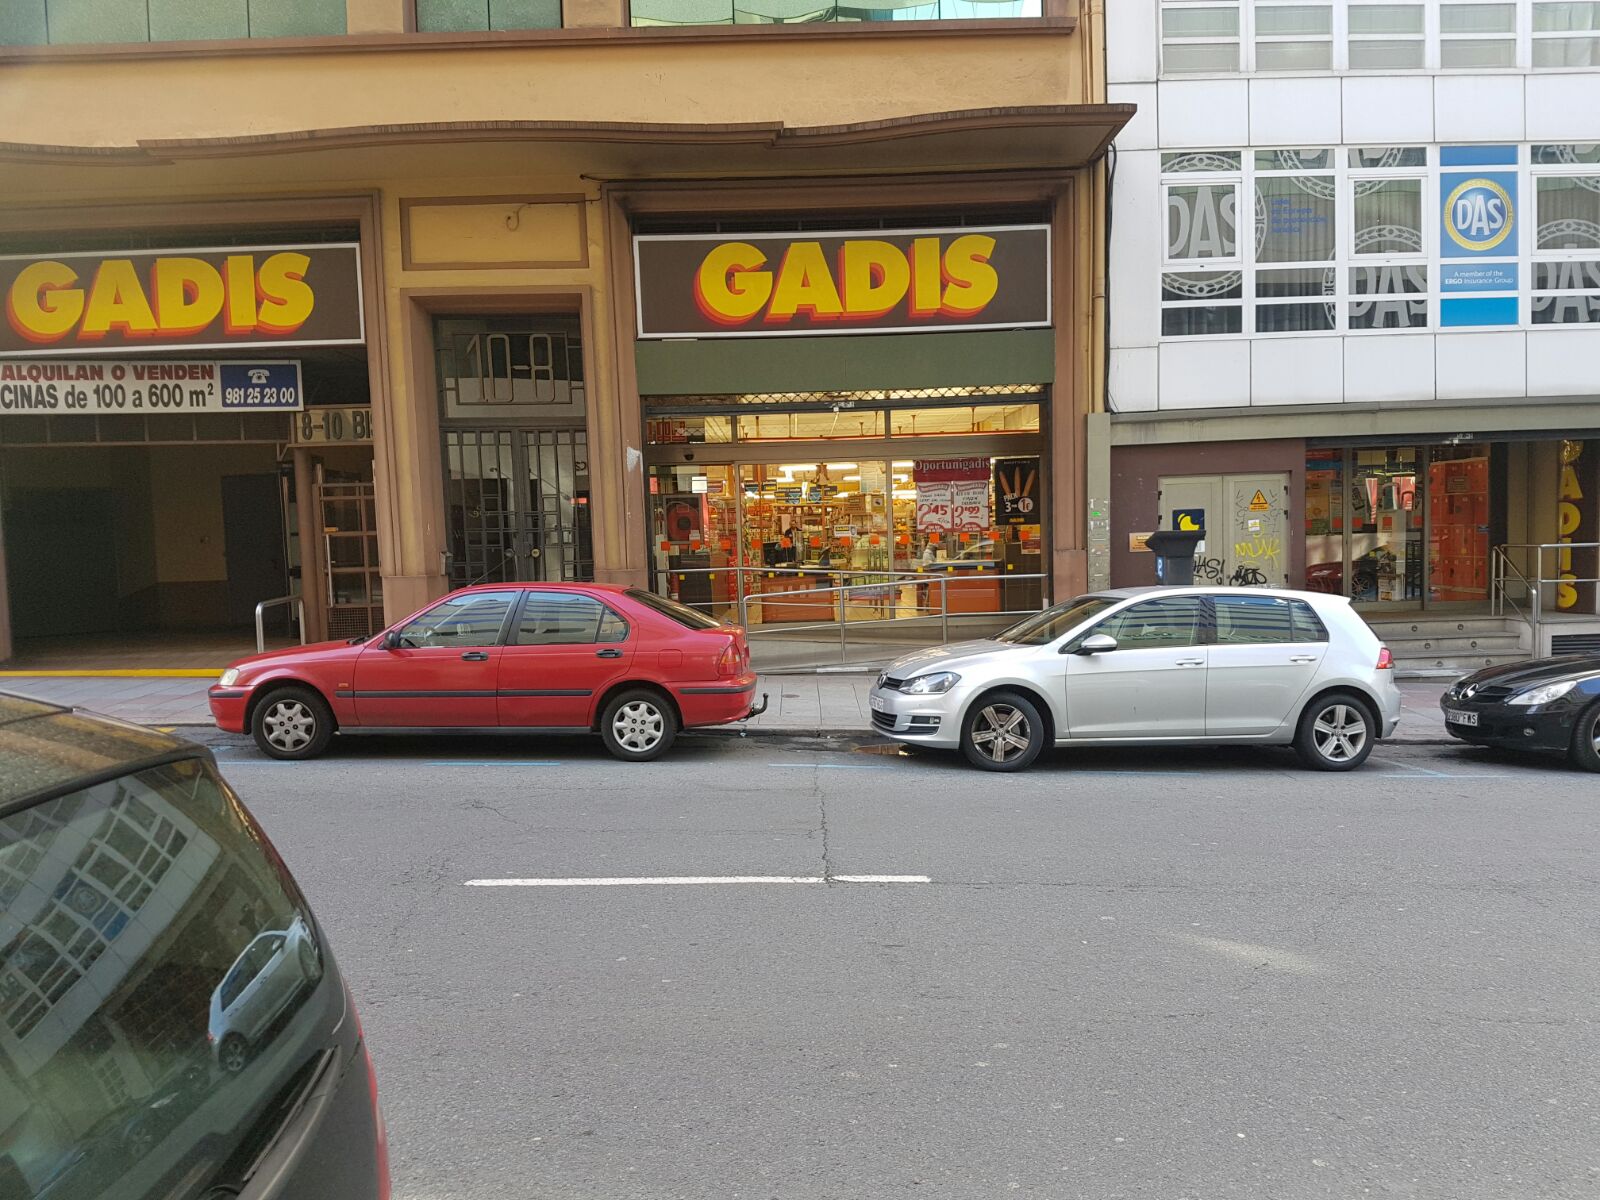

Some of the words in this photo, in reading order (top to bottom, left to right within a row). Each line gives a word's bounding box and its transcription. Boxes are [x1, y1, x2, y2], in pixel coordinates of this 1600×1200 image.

[1457, 195, 1504, 236] DAS
[693, 234, 999, 326] GADIS
[1494, 276, 1514, 284] Group
[6, 252, 315, 344] GADIS
[1, 365, 104, 383] ALQUILAN
[111, 365, 126, 381] O
[132, 364, 215, 381] VENDEN
[64, 384, 88, 409] de
[93, 383, 126, 409] 100
[132, 389, 143, 408] a
[148, 383, 184, 408] 600
[225, 388, 245, 405] 981
[247, 387, 261, 404] 25
[263, 386, 277, 404] 23
[280, 387, 295, 403] 00
[913, 457, 991, 472] Oportunigadis
